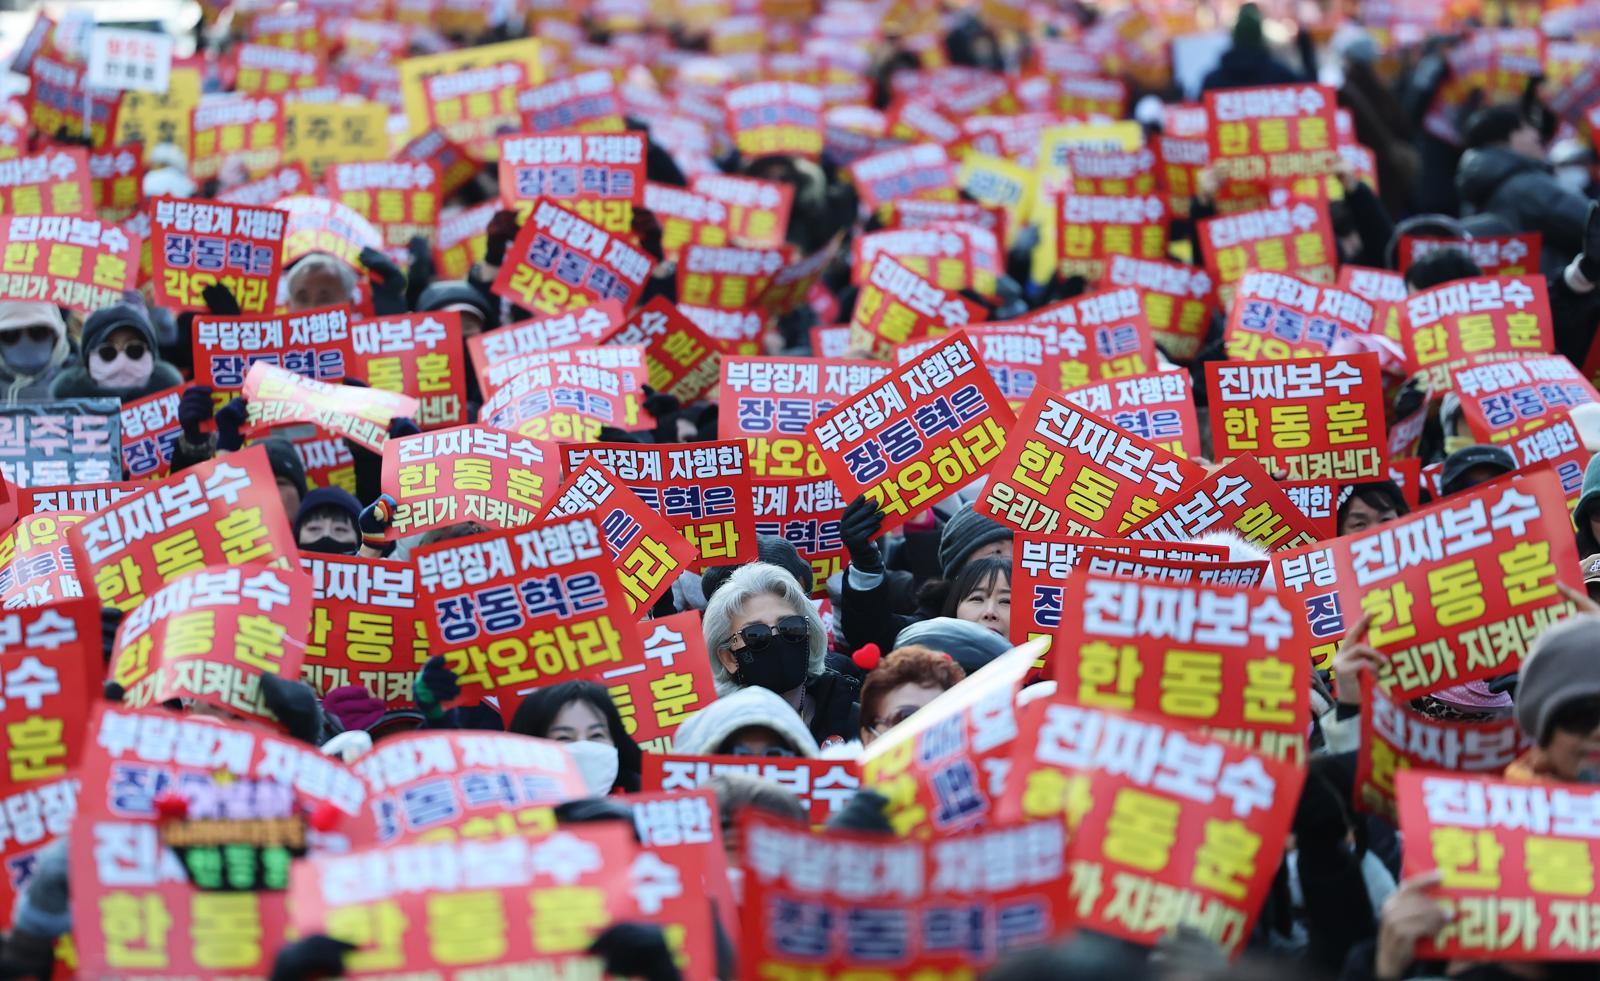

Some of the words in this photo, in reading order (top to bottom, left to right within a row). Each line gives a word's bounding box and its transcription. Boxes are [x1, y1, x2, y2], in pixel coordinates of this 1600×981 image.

[198, 321, 283, 351] 부당징계
[289, 309, 348, 346] 자행한
[352, 317, 446, 355] 짜보수
[726, 362, 819, 394] 부당징계
[814, 382, 908, 453] 부당징계
[900, 339, 976, 401] 자행한
[1114, 373, 1186, 409] 자행한
[1218, 360, 1362, 401] 진짜보수
[121, 392, 180, 438] 당징계
[398, 428, 544, 466] 진짜보수
[843, 384, 990, 485] 장동혁은
[1034, 398, 1184, 496] 진짜보수
[669, 445, 744, 481] 자행한
[861, 416, 1008, 516] 각오하라
[80, 462, 251, 564] 진짜보수
[391, 496, 458, 532] 우리가
[464, 494, 537, 528] 지켜낸
[986, 481, 1060, 537] 우리가
[1351, 486, 1541, 587] 진짜보수
[417, 536, 514, 593] 부당징계
[514, 518, 601, 570] 자행한
[120, 568, 290, 647] 진짜보수
[435, 571, 607, 644] 장동혁은
[1084, 579, 1295, 650] 진짜보수
[444, 616, 624, 692] 각오하라
[1034, 702, 1276, 819] 진짜보수
